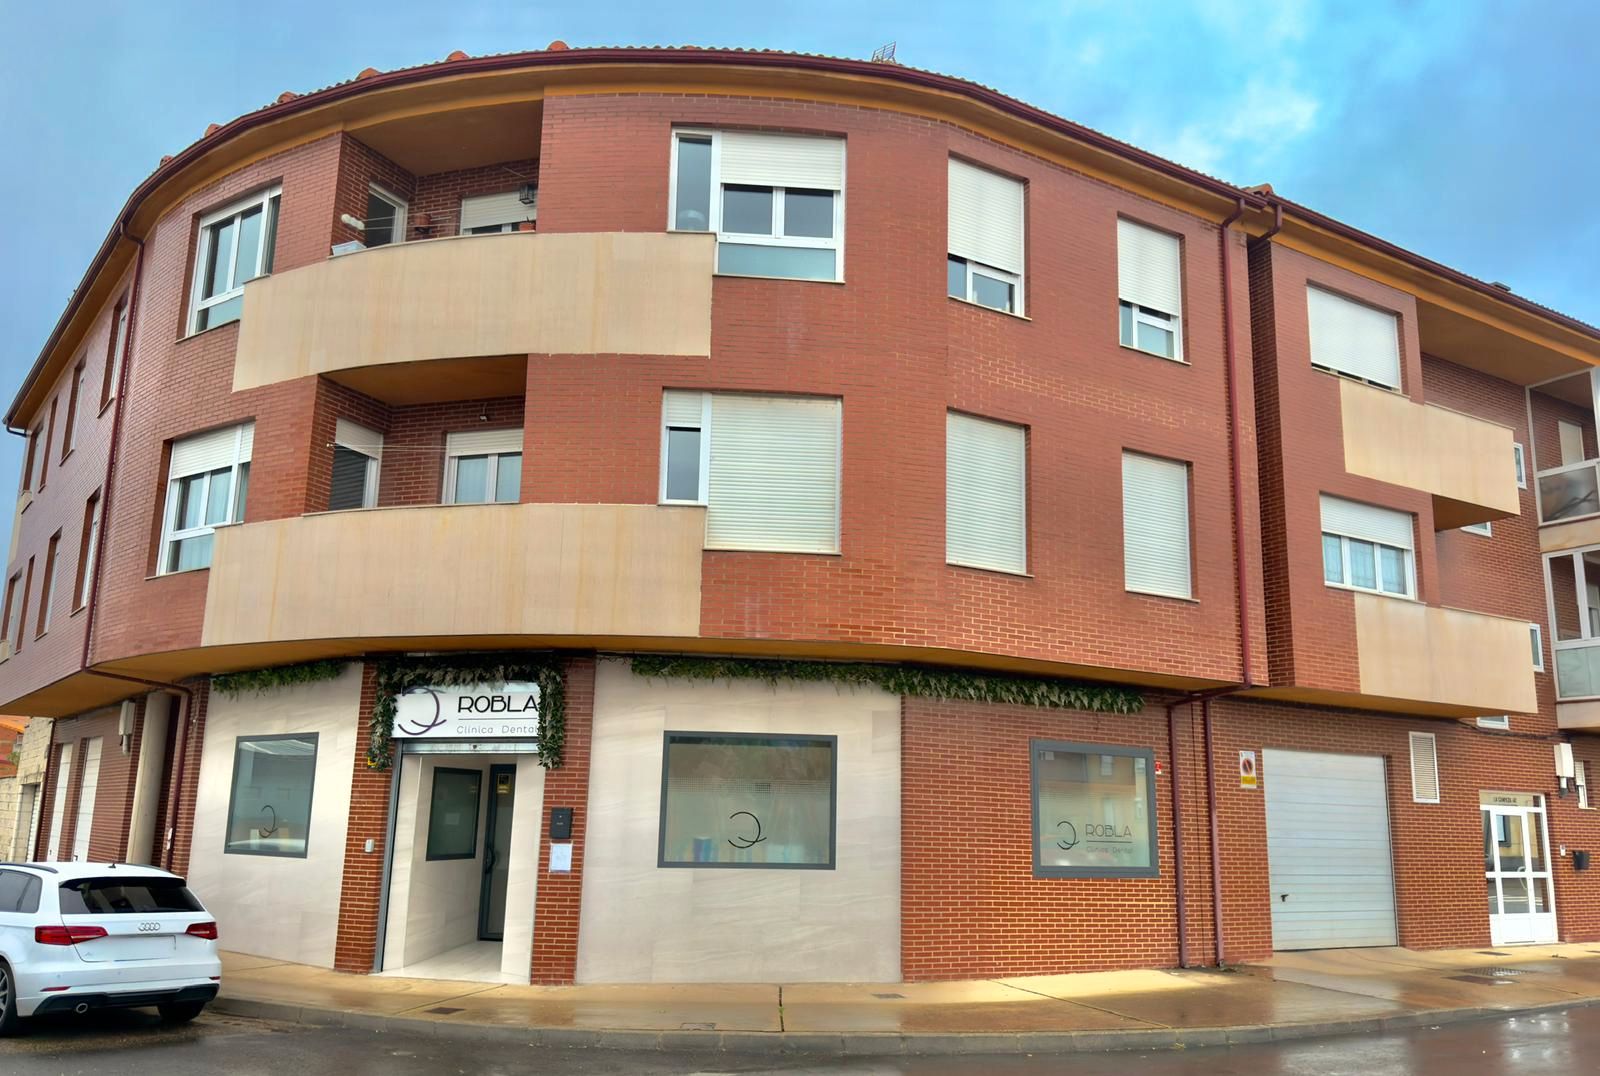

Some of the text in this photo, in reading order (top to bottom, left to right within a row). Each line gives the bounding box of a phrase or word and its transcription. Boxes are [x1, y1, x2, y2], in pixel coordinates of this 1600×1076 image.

[458, 695, 539, 713] ROBLA
[501, 725, 539, 734] Dental
[1085, 823, 1132, 837] ROBLA
